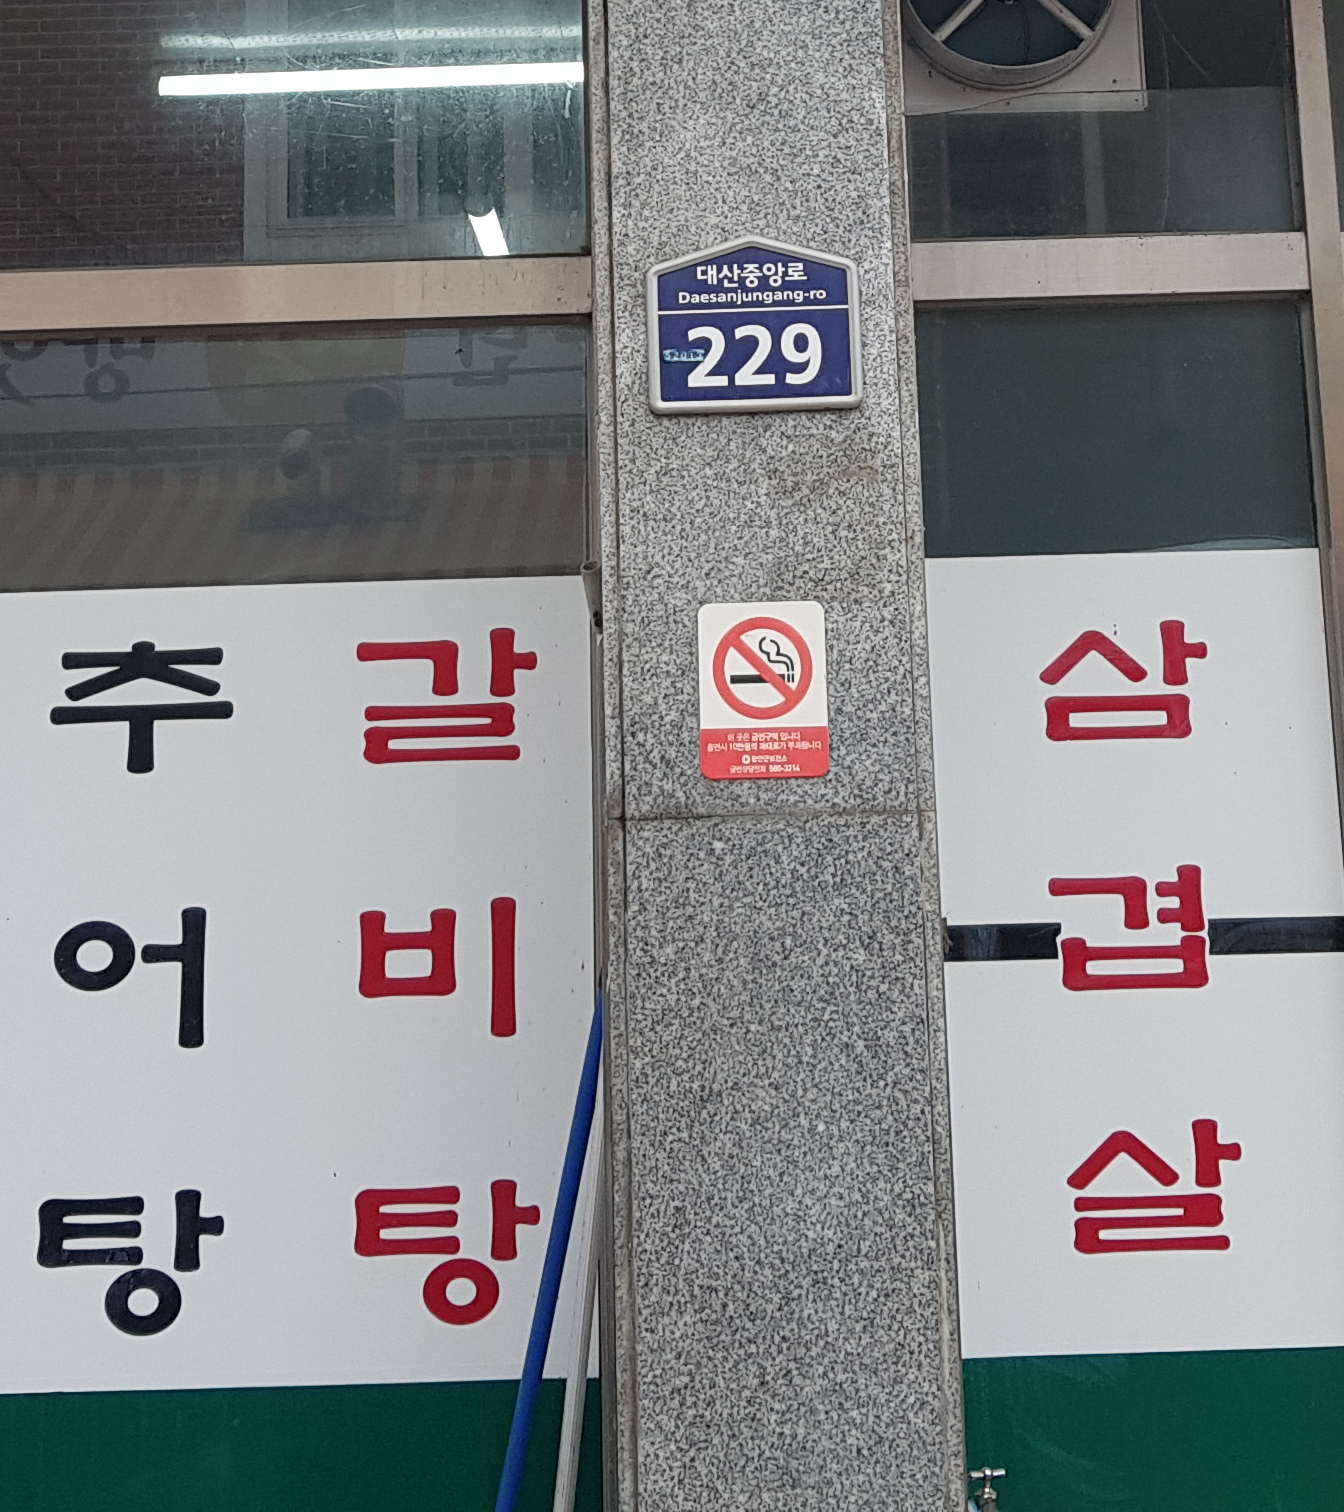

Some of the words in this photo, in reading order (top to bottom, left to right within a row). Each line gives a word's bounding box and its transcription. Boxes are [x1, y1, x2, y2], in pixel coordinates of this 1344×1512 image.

[678, 289, 827, 305] Daesanjungang-ro
[687, 322, 823, 388] 229
[696, 261, 808, 288] 대산중앙로
[37, 640, 234, 1336] 추어탕
[353, 627, 541, 1326] 갈비탕
[1039, 619, 1243, 1255] 삼겹살
